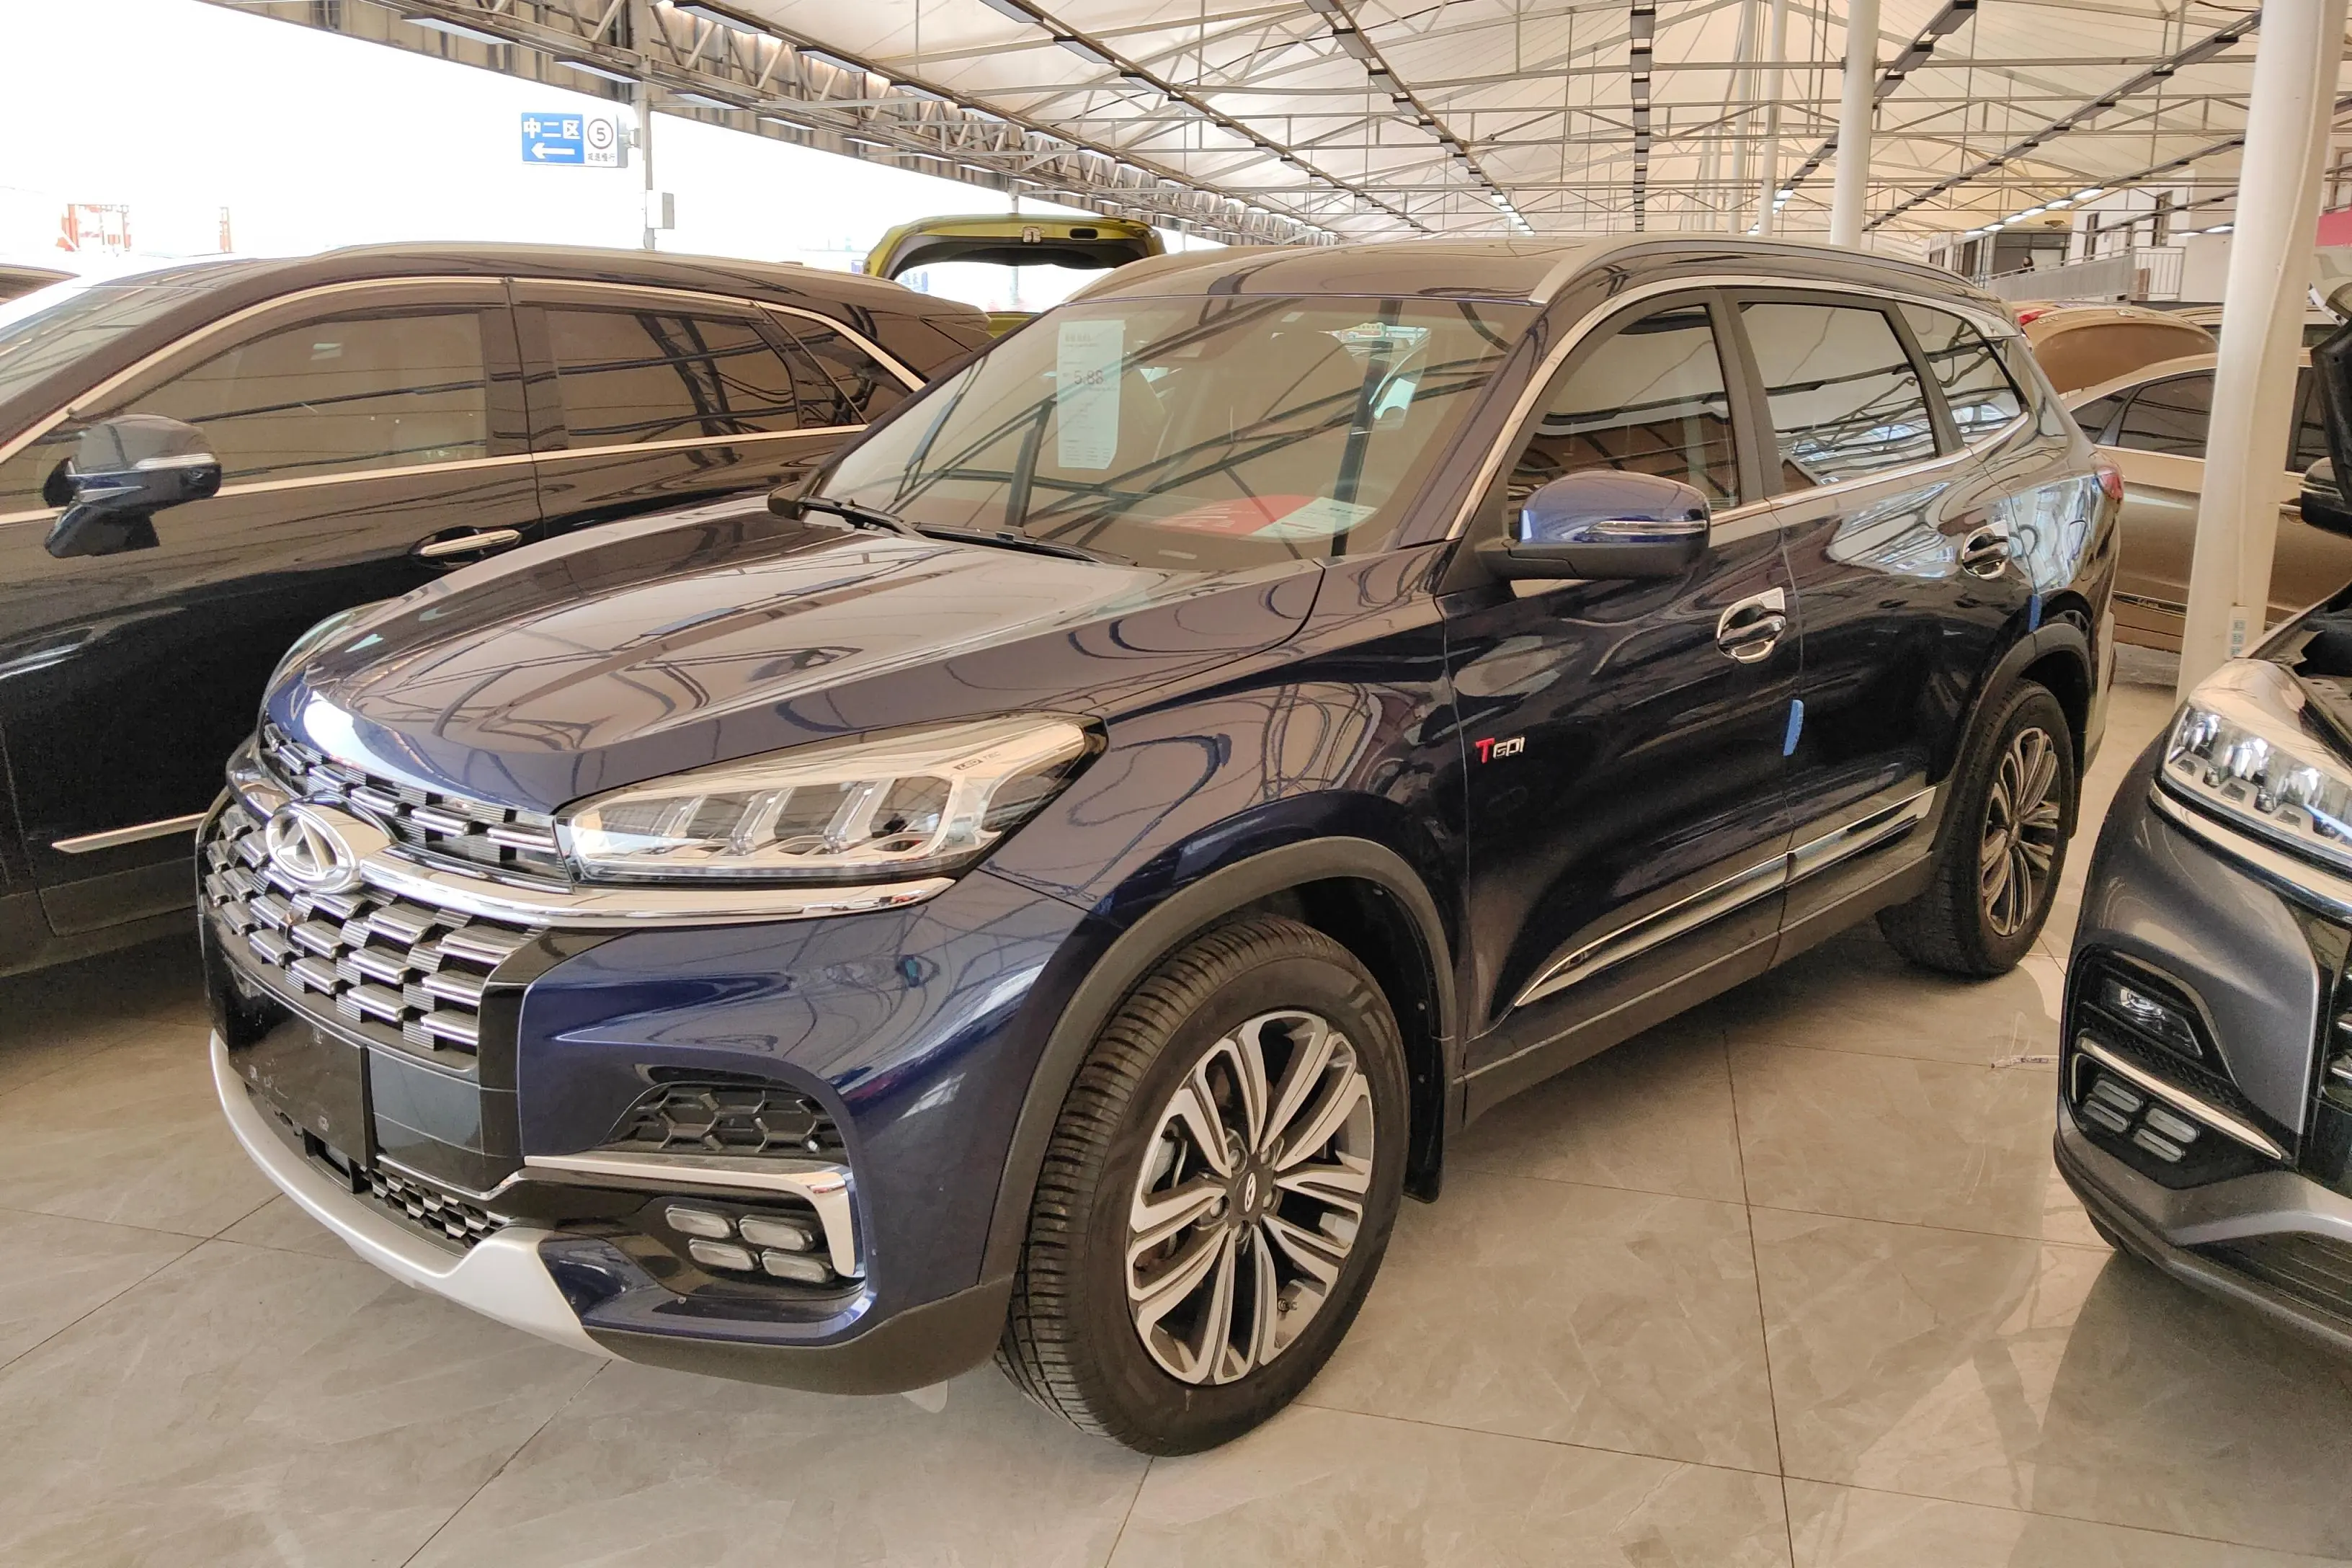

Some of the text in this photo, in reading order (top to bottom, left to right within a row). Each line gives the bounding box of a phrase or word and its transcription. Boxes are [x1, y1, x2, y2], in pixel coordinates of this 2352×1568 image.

[523, 117, 581, 140] 中二区
[597, 128, 606, 142] 5
[1475, 736, 1525, 764] TGDI
